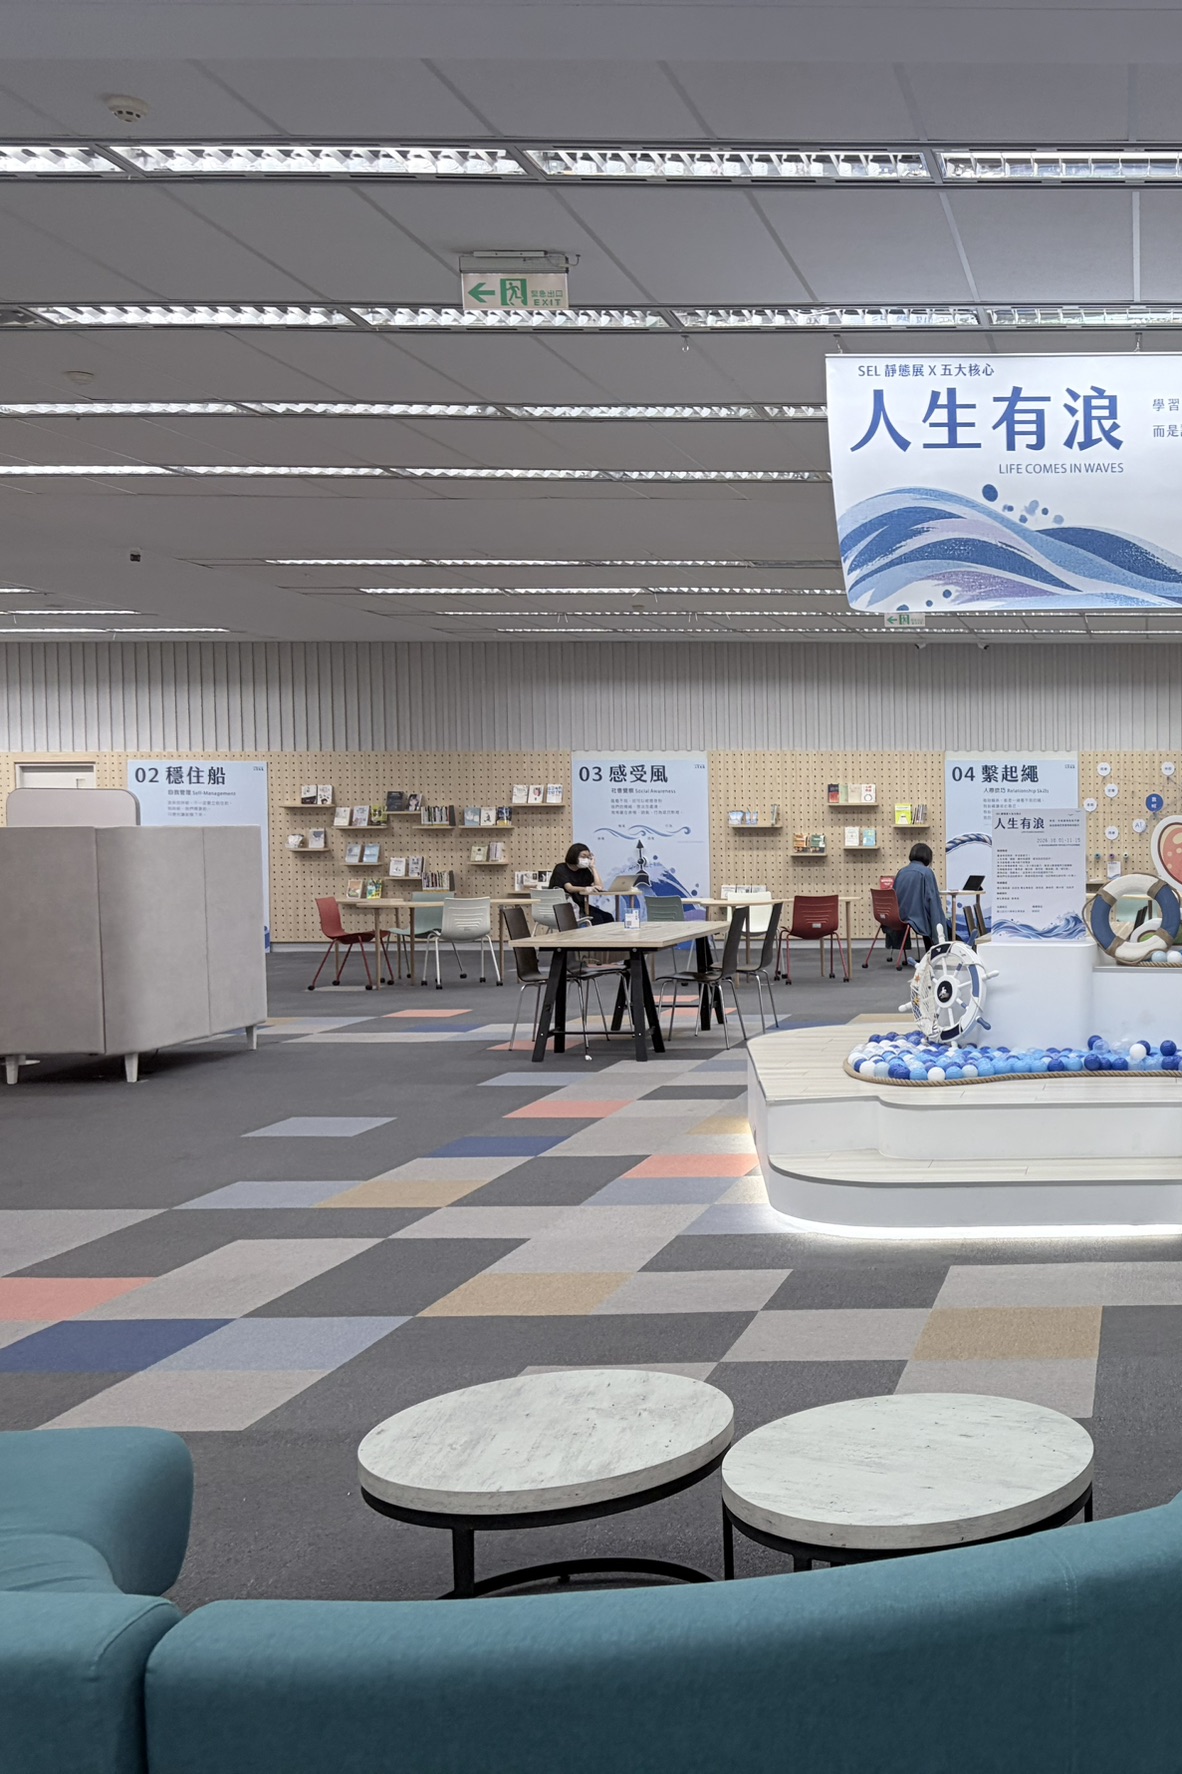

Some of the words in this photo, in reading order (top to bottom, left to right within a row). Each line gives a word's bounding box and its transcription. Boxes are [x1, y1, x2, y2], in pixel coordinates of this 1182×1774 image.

[858, 365, 881, 377] SEL
[884, 364, 925, 377] 靜態展
[928, 364, 937, 376] X
[941, 363, 995, 377] 五大核心
[850, 385, 1124, 453] 人生有浪
[999, 463, 1023, 474] LIFE
[1025, 463, 1068, 474] COMES
[1069, 463, 1082, 473] IN
[1084, 462, 1124, 473] WAVES
[135, 767, 159, 783] 02
[165, 766, 226, 785] 穩住船
[579, 766, 603, 782] 03
[608, 764, 668, 783] 感受風
[951, 766, 976, 782] 04
[981, 764, 1040, 783] 繫起繩
[994, 817, 1045, 830] 人生有浪
